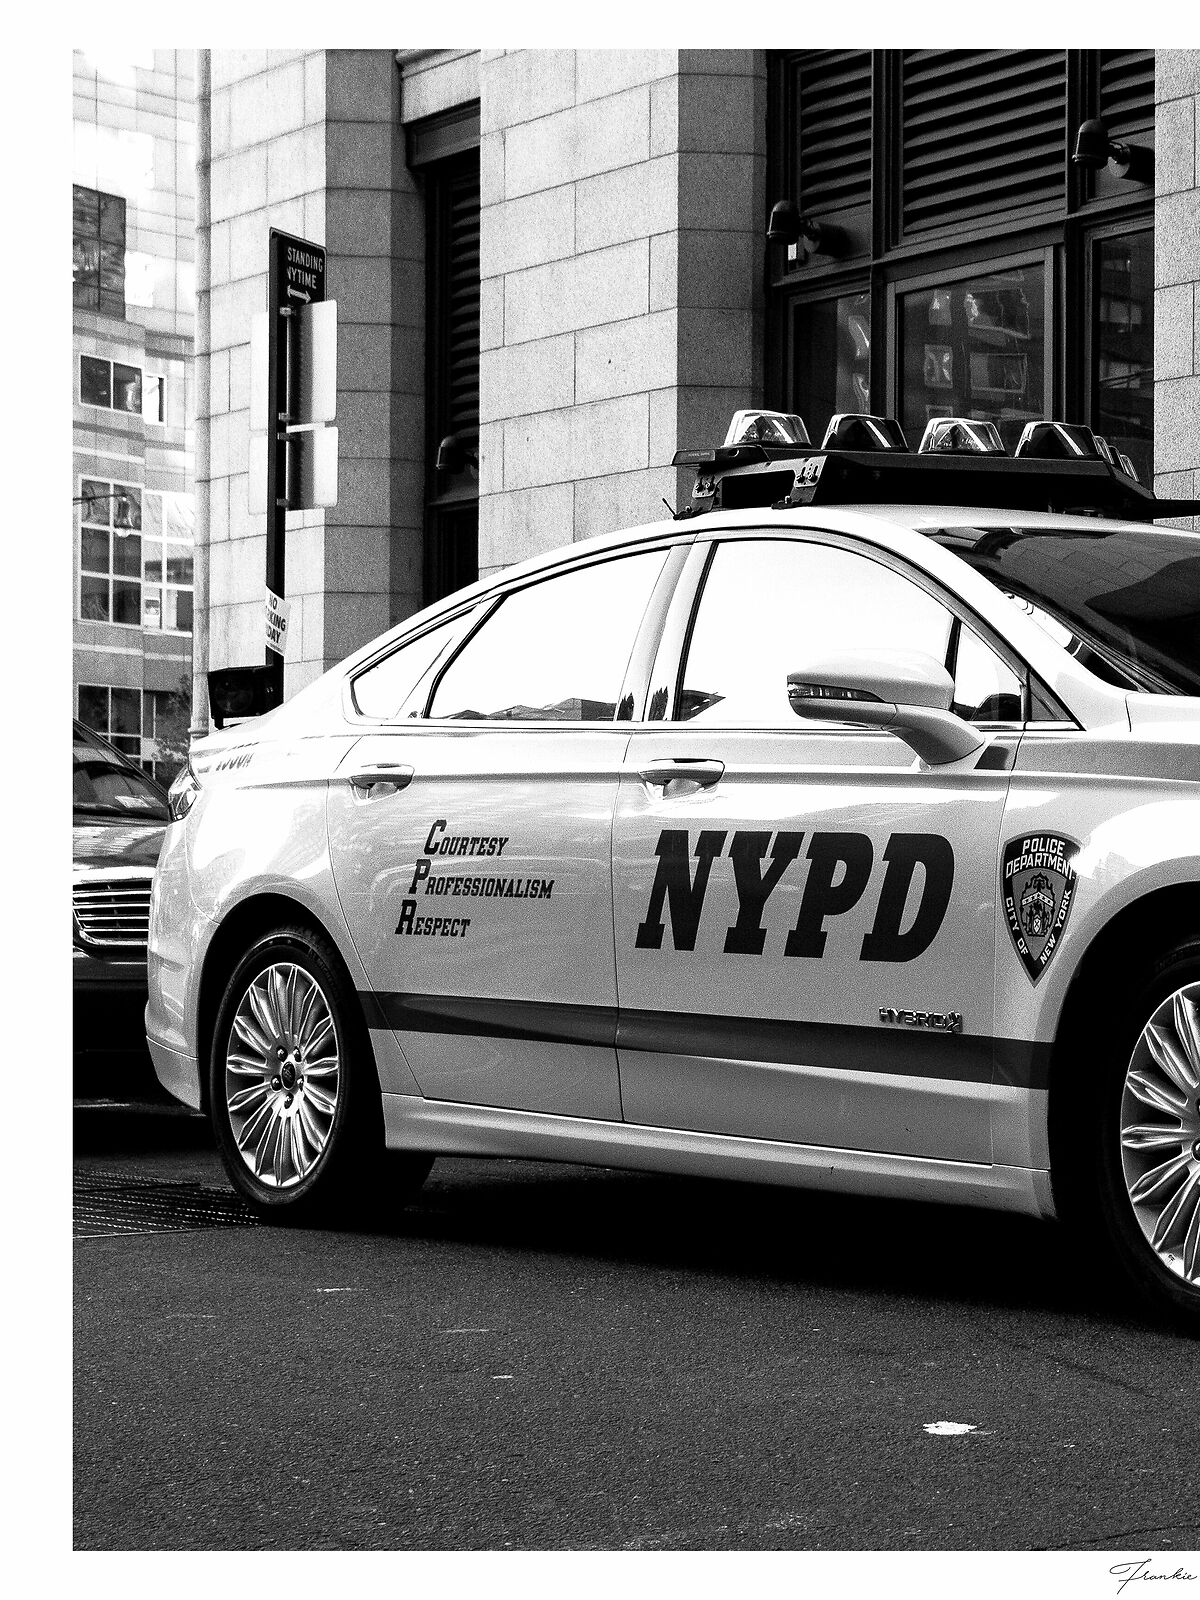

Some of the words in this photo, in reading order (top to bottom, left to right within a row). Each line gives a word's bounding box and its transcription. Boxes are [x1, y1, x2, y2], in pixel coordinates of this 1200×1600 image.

[287, 246, 323, 273] STANDING
[424, 819, 509, 856] COURTESY
[1022, 837, 1066, 857] POLICE
[408, 858, 555, 899] PROFESSIONALISM
[635, 829, 955, 963] NYPD
[395, 899, 471, 938] RESPECT
[1005, 896, 1020, 932] CITY
[1017, 937, 1029, 956] OF
[1039, 934, 1057, 965] NEW
[1055, 889, 1072, 929] YORK
[879, 1006, 947, 1030] HYBRID
